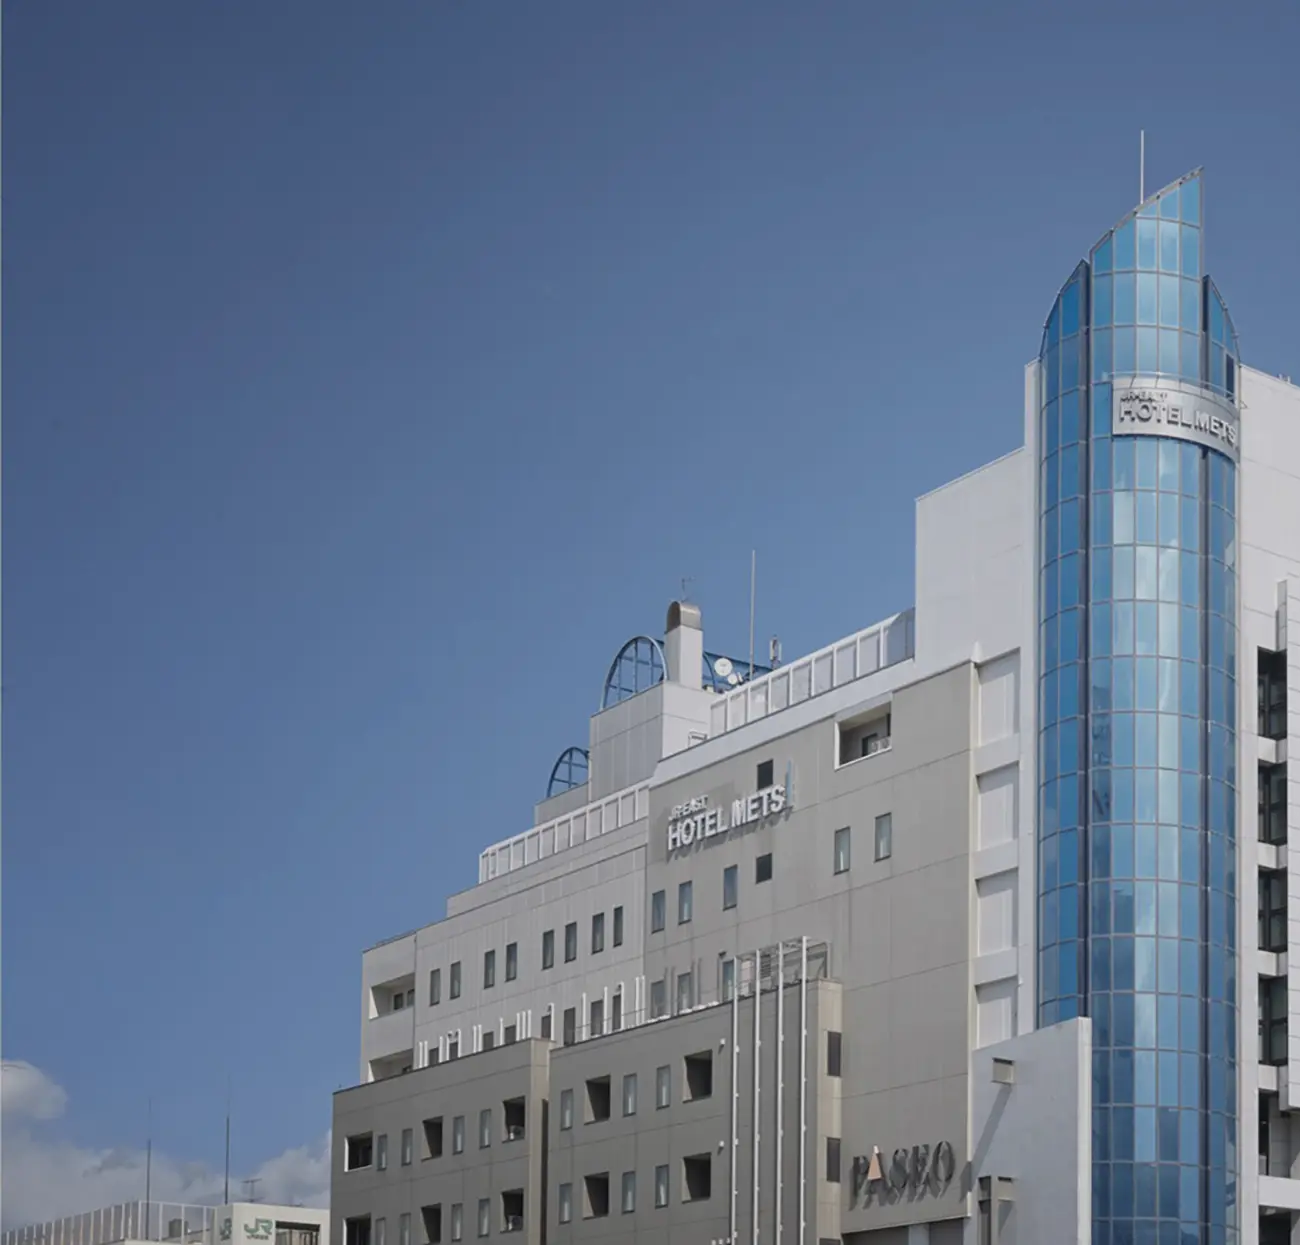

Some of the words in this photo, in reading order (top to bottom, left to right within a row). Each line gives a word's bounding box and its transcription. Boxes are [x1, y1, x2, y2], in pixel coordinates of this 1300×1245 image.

[1120, 402, 1192, 429] HOTEL
[1194, 411, 1237, 446] METS
[668, 805, 728, 850] HOTEL
[731, 784, 786, 828] METS
[852, 1141, 956, 1199] PASEO
[244, 1218, 273, 1235] JR
